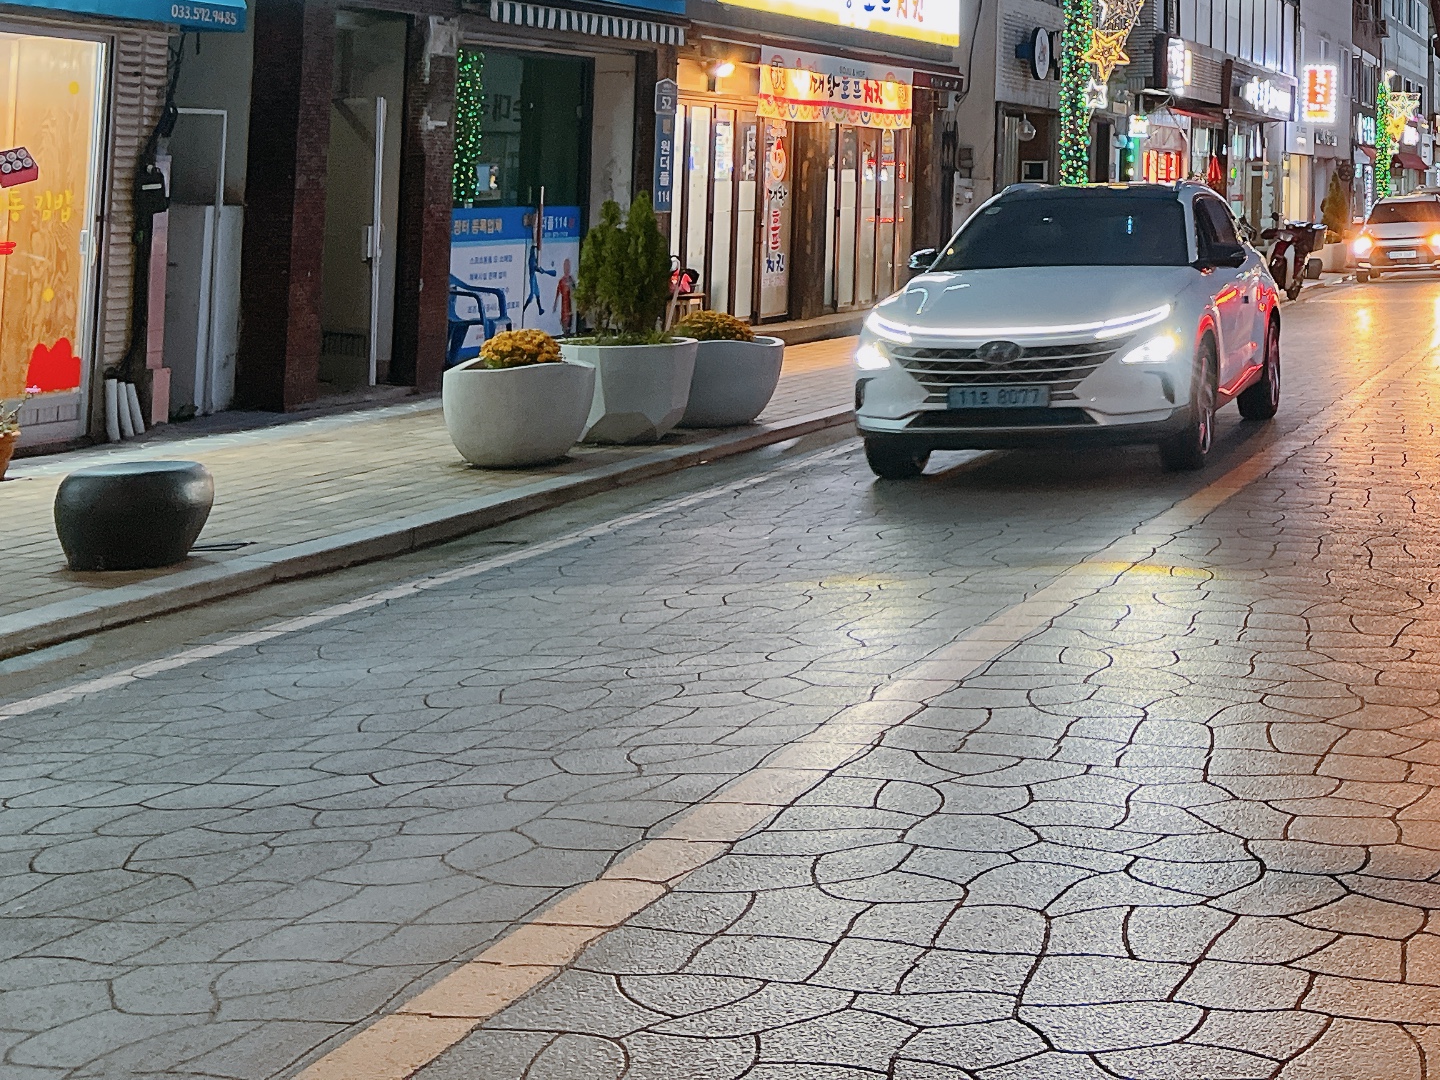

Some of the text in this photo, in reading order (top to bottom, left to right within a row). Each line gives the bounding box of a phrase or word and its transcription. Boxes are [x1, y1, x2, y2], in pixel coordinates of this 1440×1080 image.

[661, 96, 672, 111] 52
[657, 190, 670, 203] 114
[34, 189, 74, 223] 김밥
